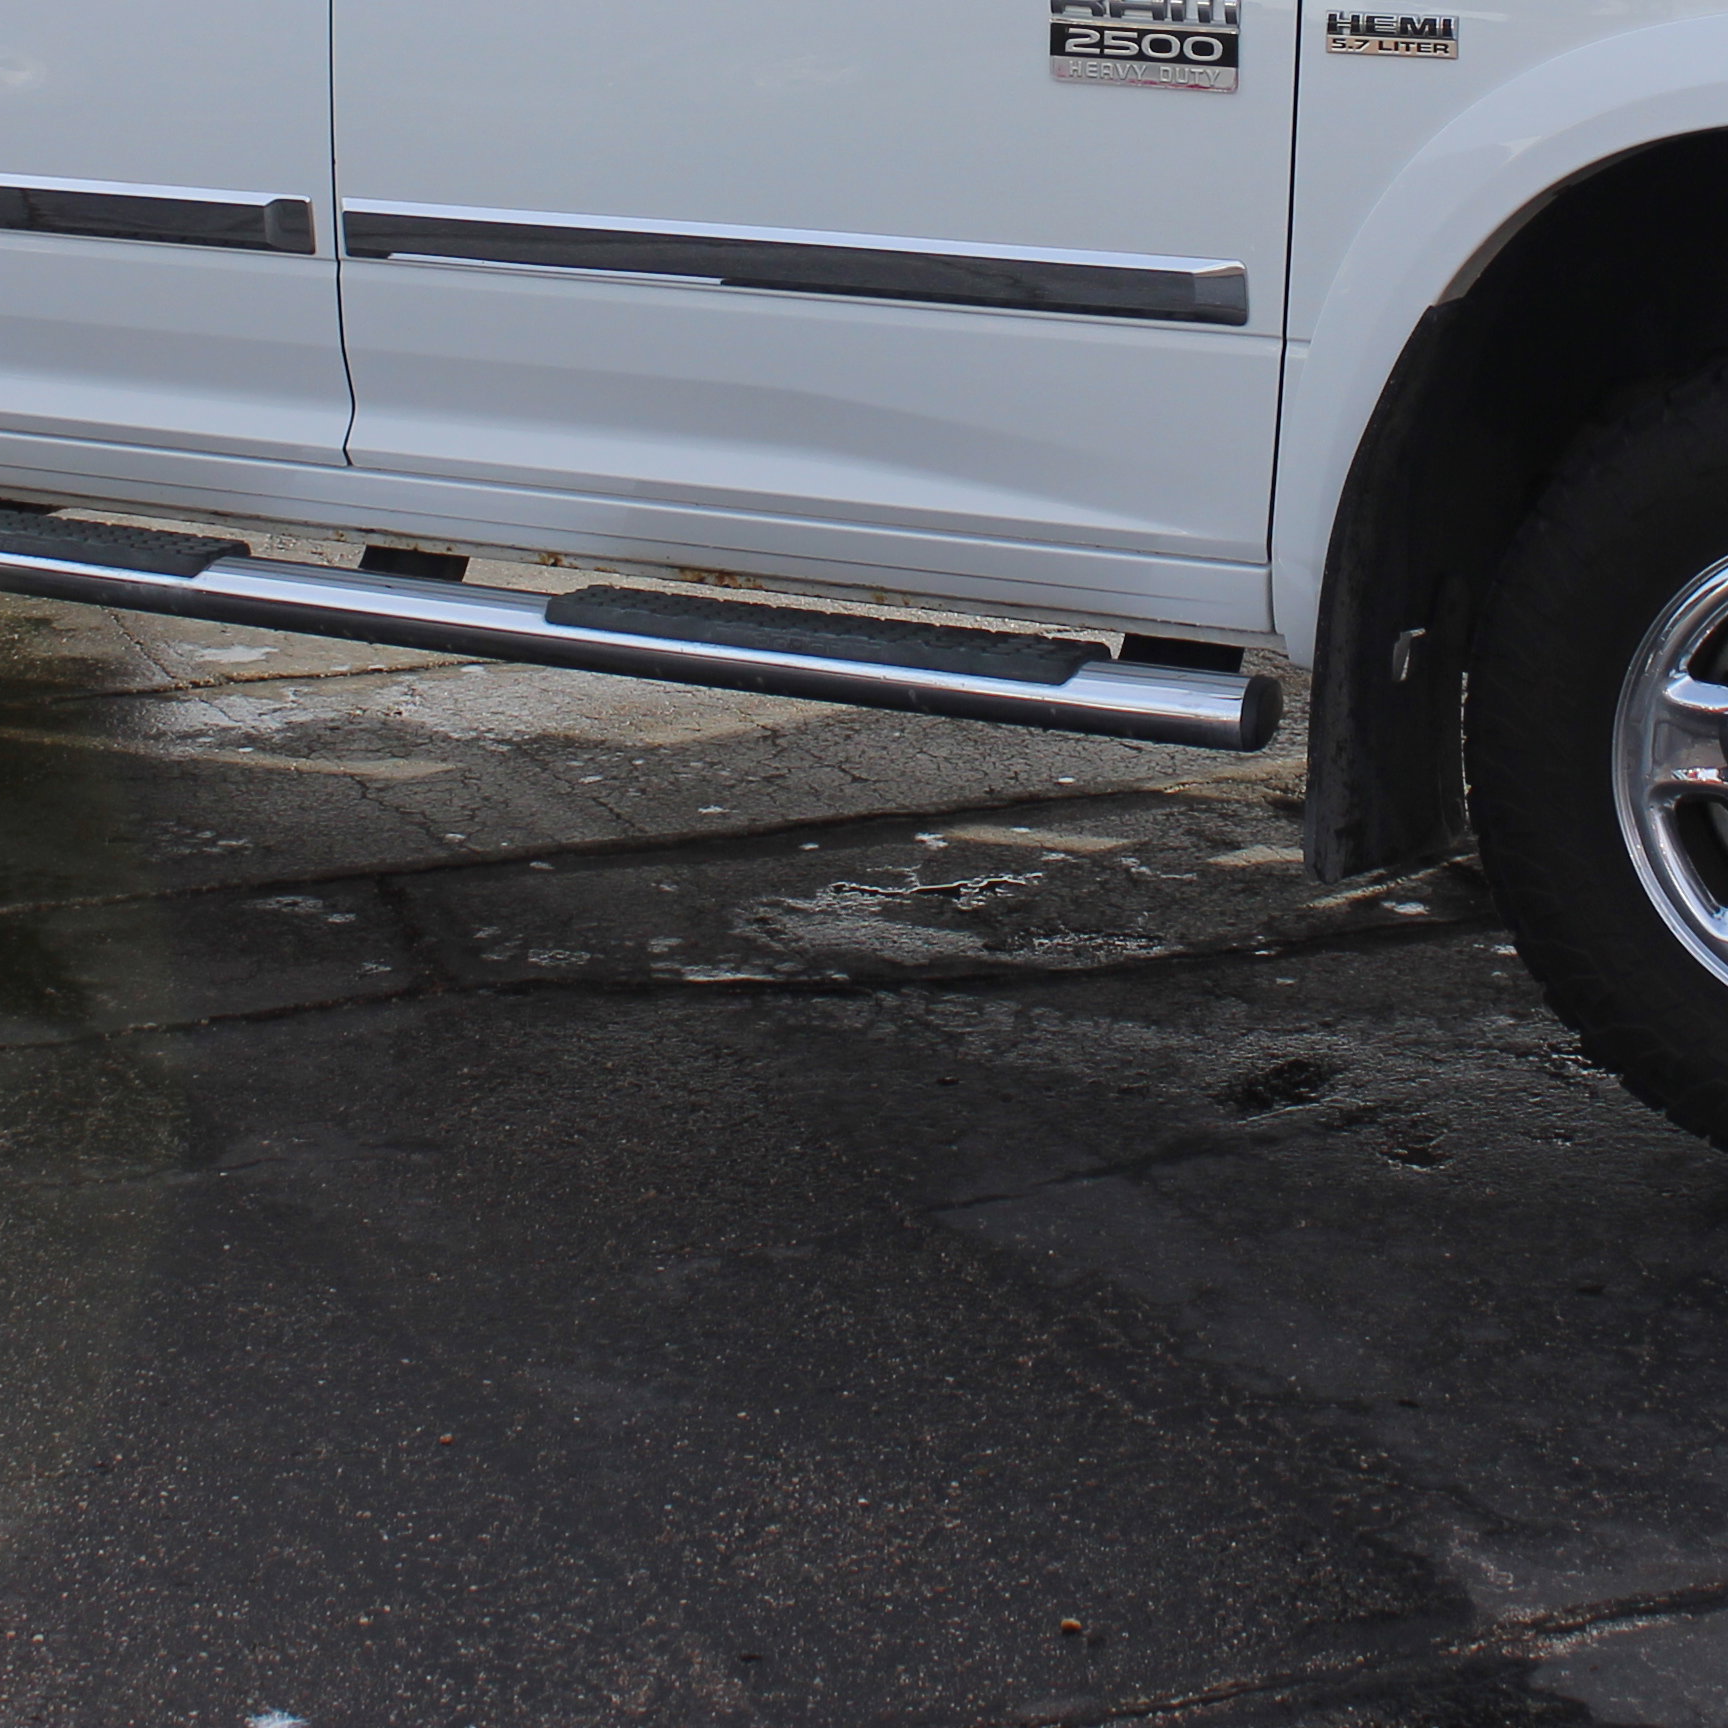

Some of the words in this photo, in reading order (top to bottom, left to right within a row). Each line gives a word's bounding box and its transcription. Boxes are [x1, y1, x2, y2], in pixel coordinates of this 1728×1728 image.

[1327, 11, 1456, 39] HEMI
[1064, 27, 1223, 61] 2500
[1331, 38, 1370, 53] 5.7
[1378, 39, 1450, 55] LITER
[1069, 60, 1147, 81] HEAVY
[1159, 66, 1221, 87] DUTY
